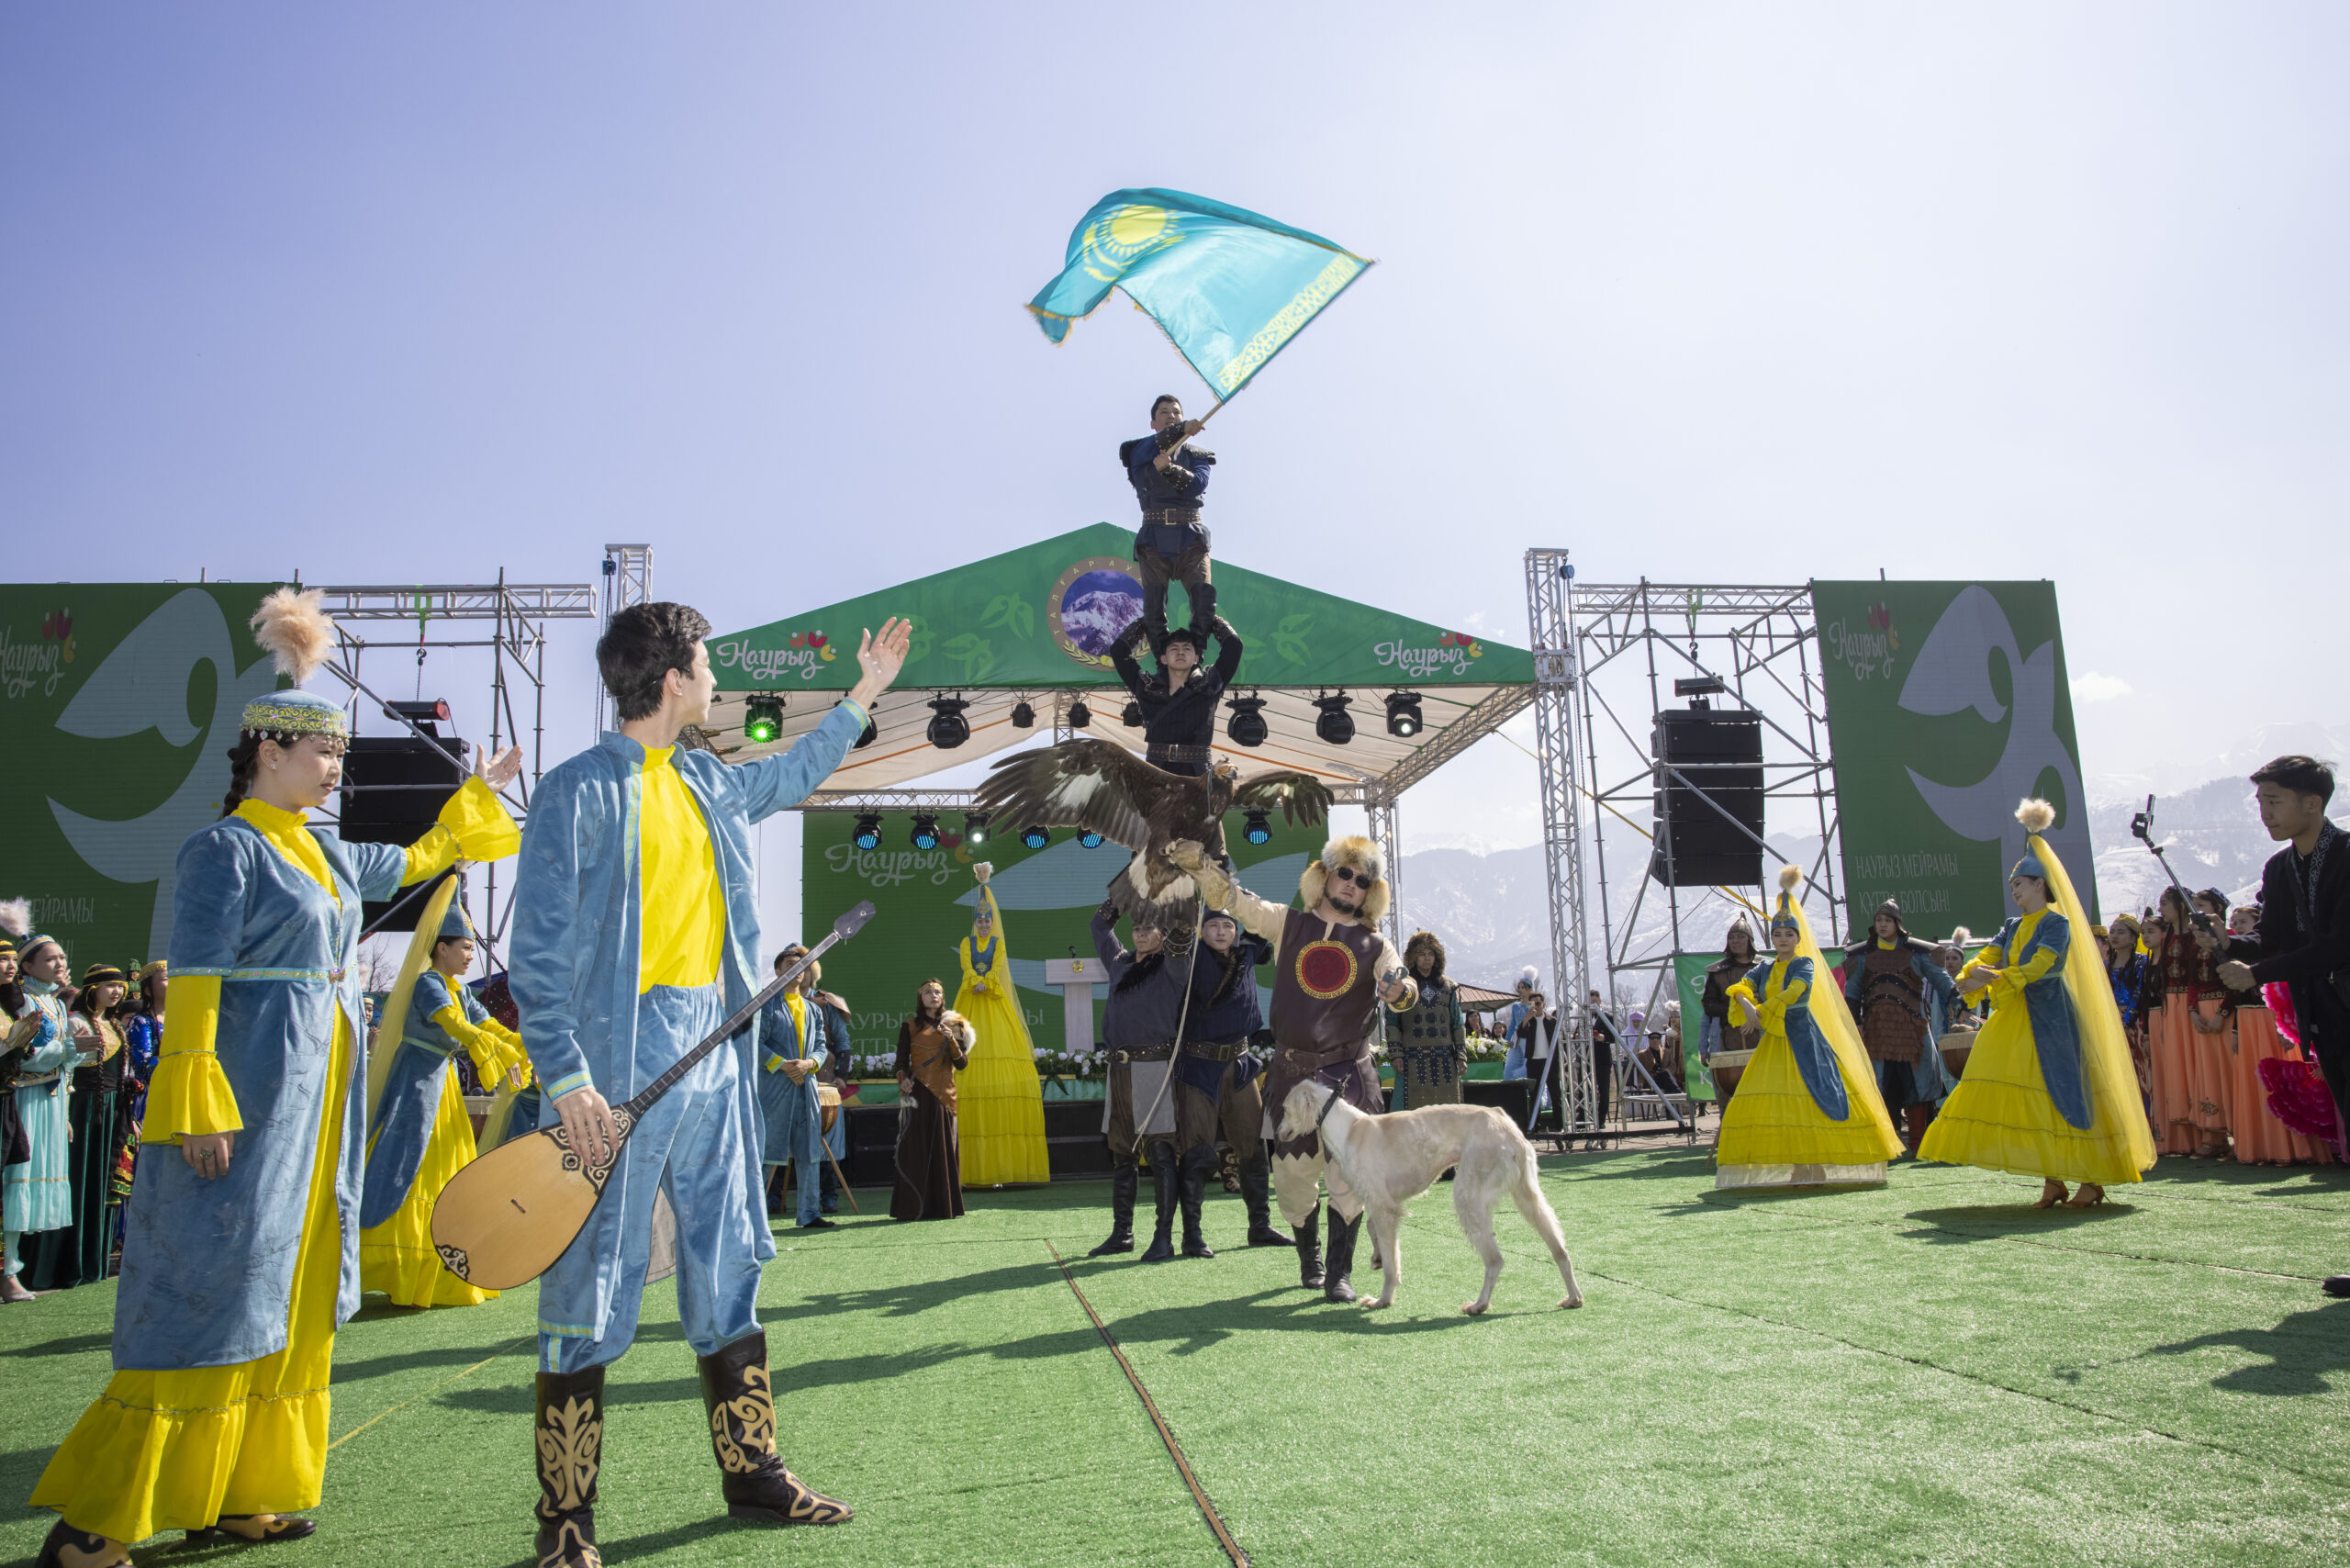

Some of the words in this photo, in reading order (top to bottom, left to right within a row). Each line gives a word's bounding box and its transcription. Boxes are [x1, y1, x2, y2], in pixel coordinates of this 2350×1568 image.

[716, 639, 826, 679] Наурыз
[1373, 639, 1474, 677] Наурыз
[1829, 617, 1895, 680] Наурыз
[824, 844, 961, 887] Наурыз
[1855, 855, 1901, 879] НАУРЫЗ
[1903, 850, 1960, 878] МЕЙРАМЫ
[32, 892, 95, 924] ЕЙРАМЫ
